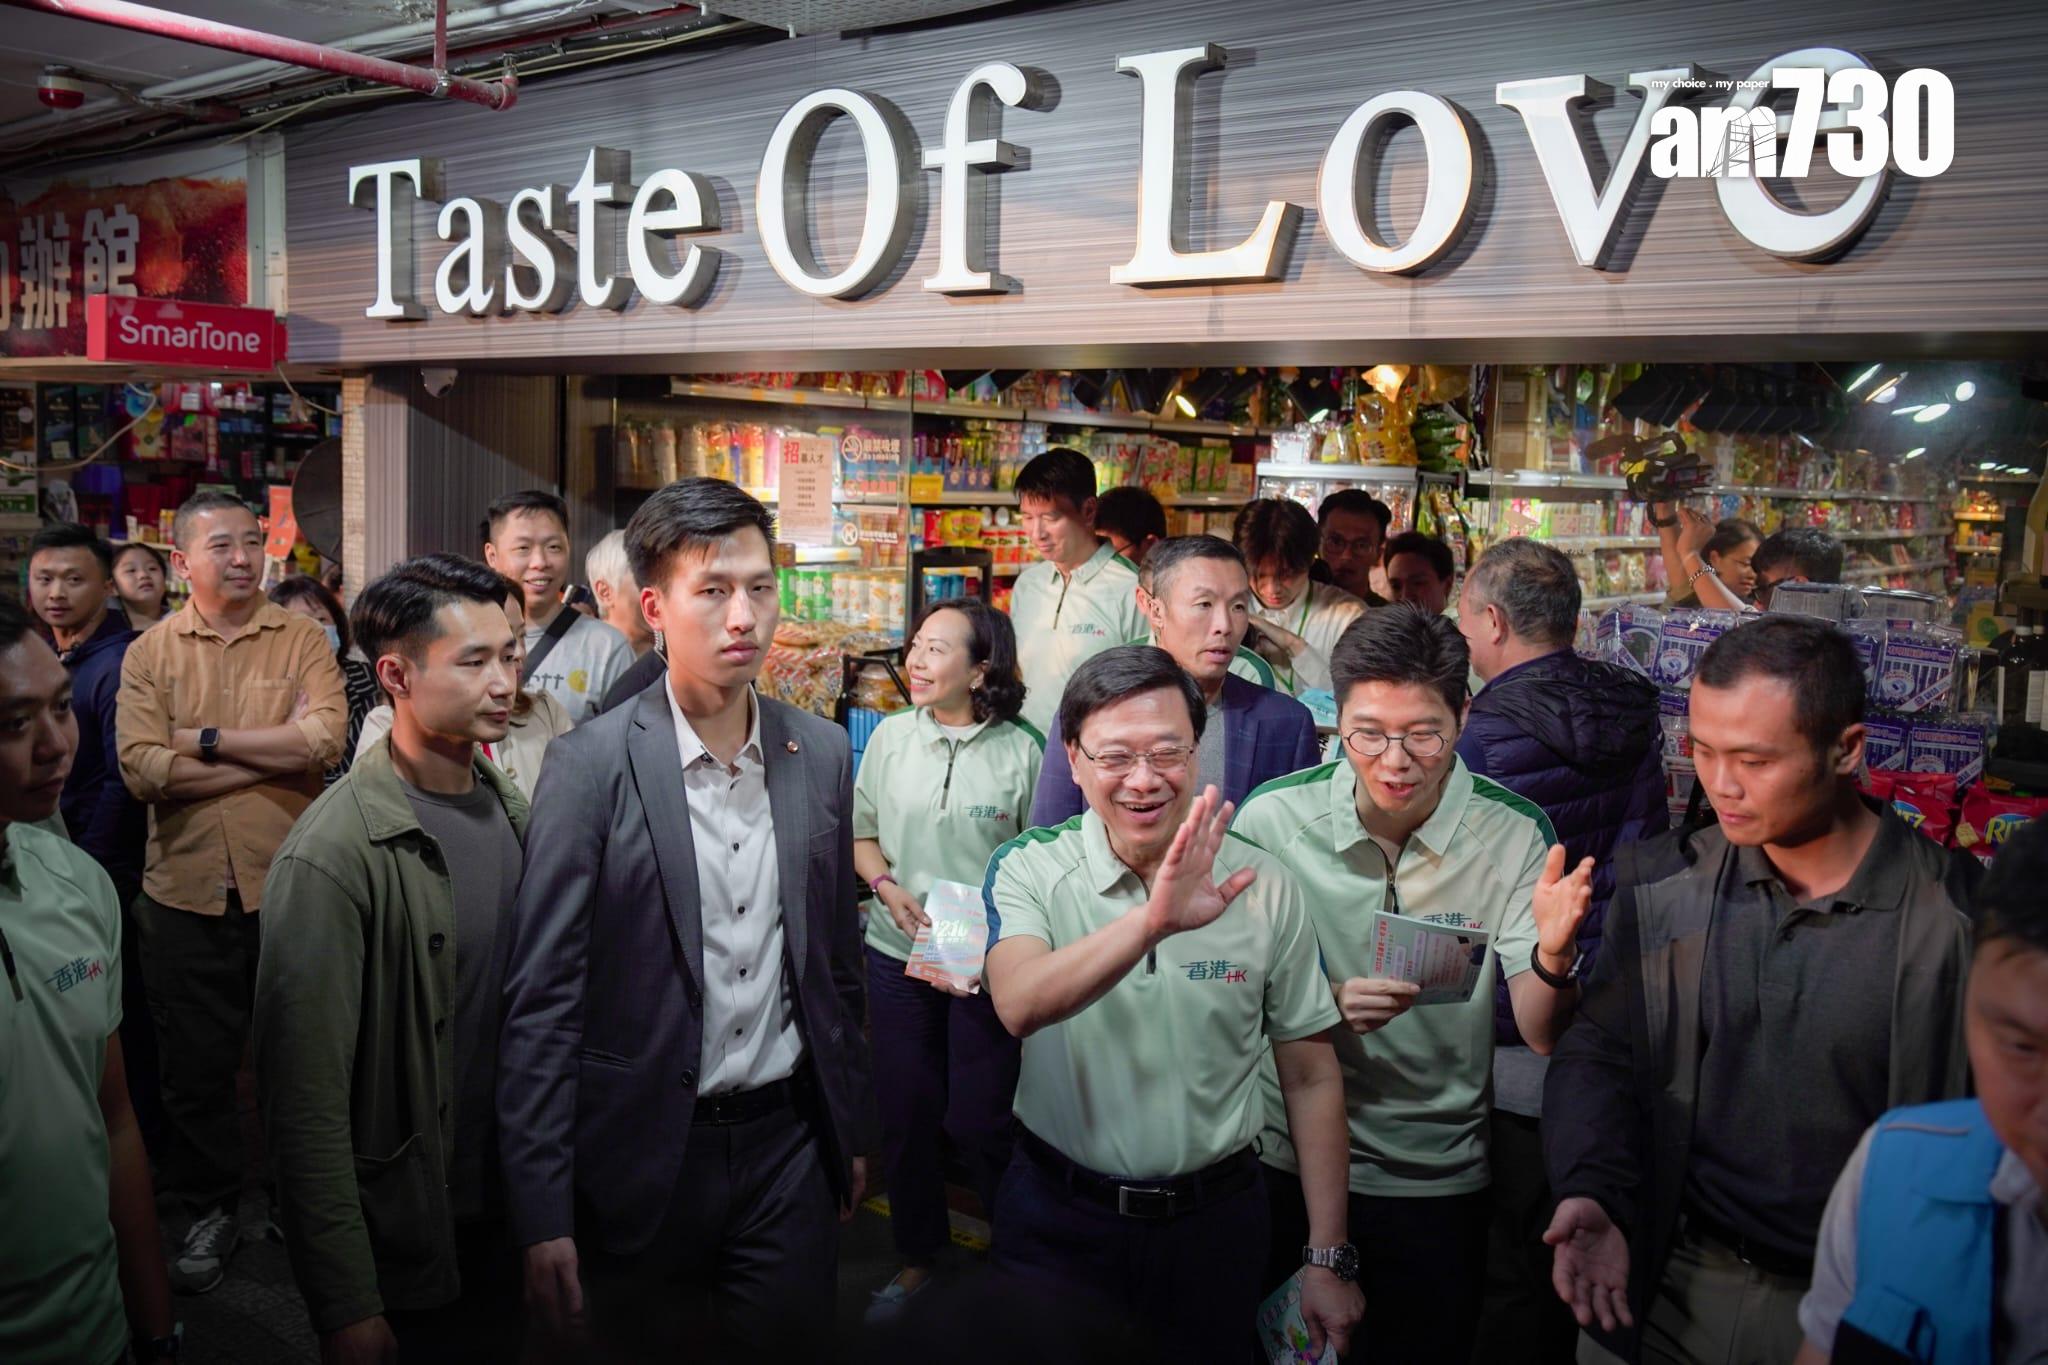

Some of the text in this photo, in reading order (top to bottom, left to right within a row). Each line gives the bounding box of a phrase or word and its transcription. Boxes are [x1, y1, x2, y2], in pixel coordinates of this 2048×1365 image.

[348, 45, 1890, 320] Taste Of Love
[119, 315, 261, 353] SmarTone
[784, 440, 800, 464] 招
